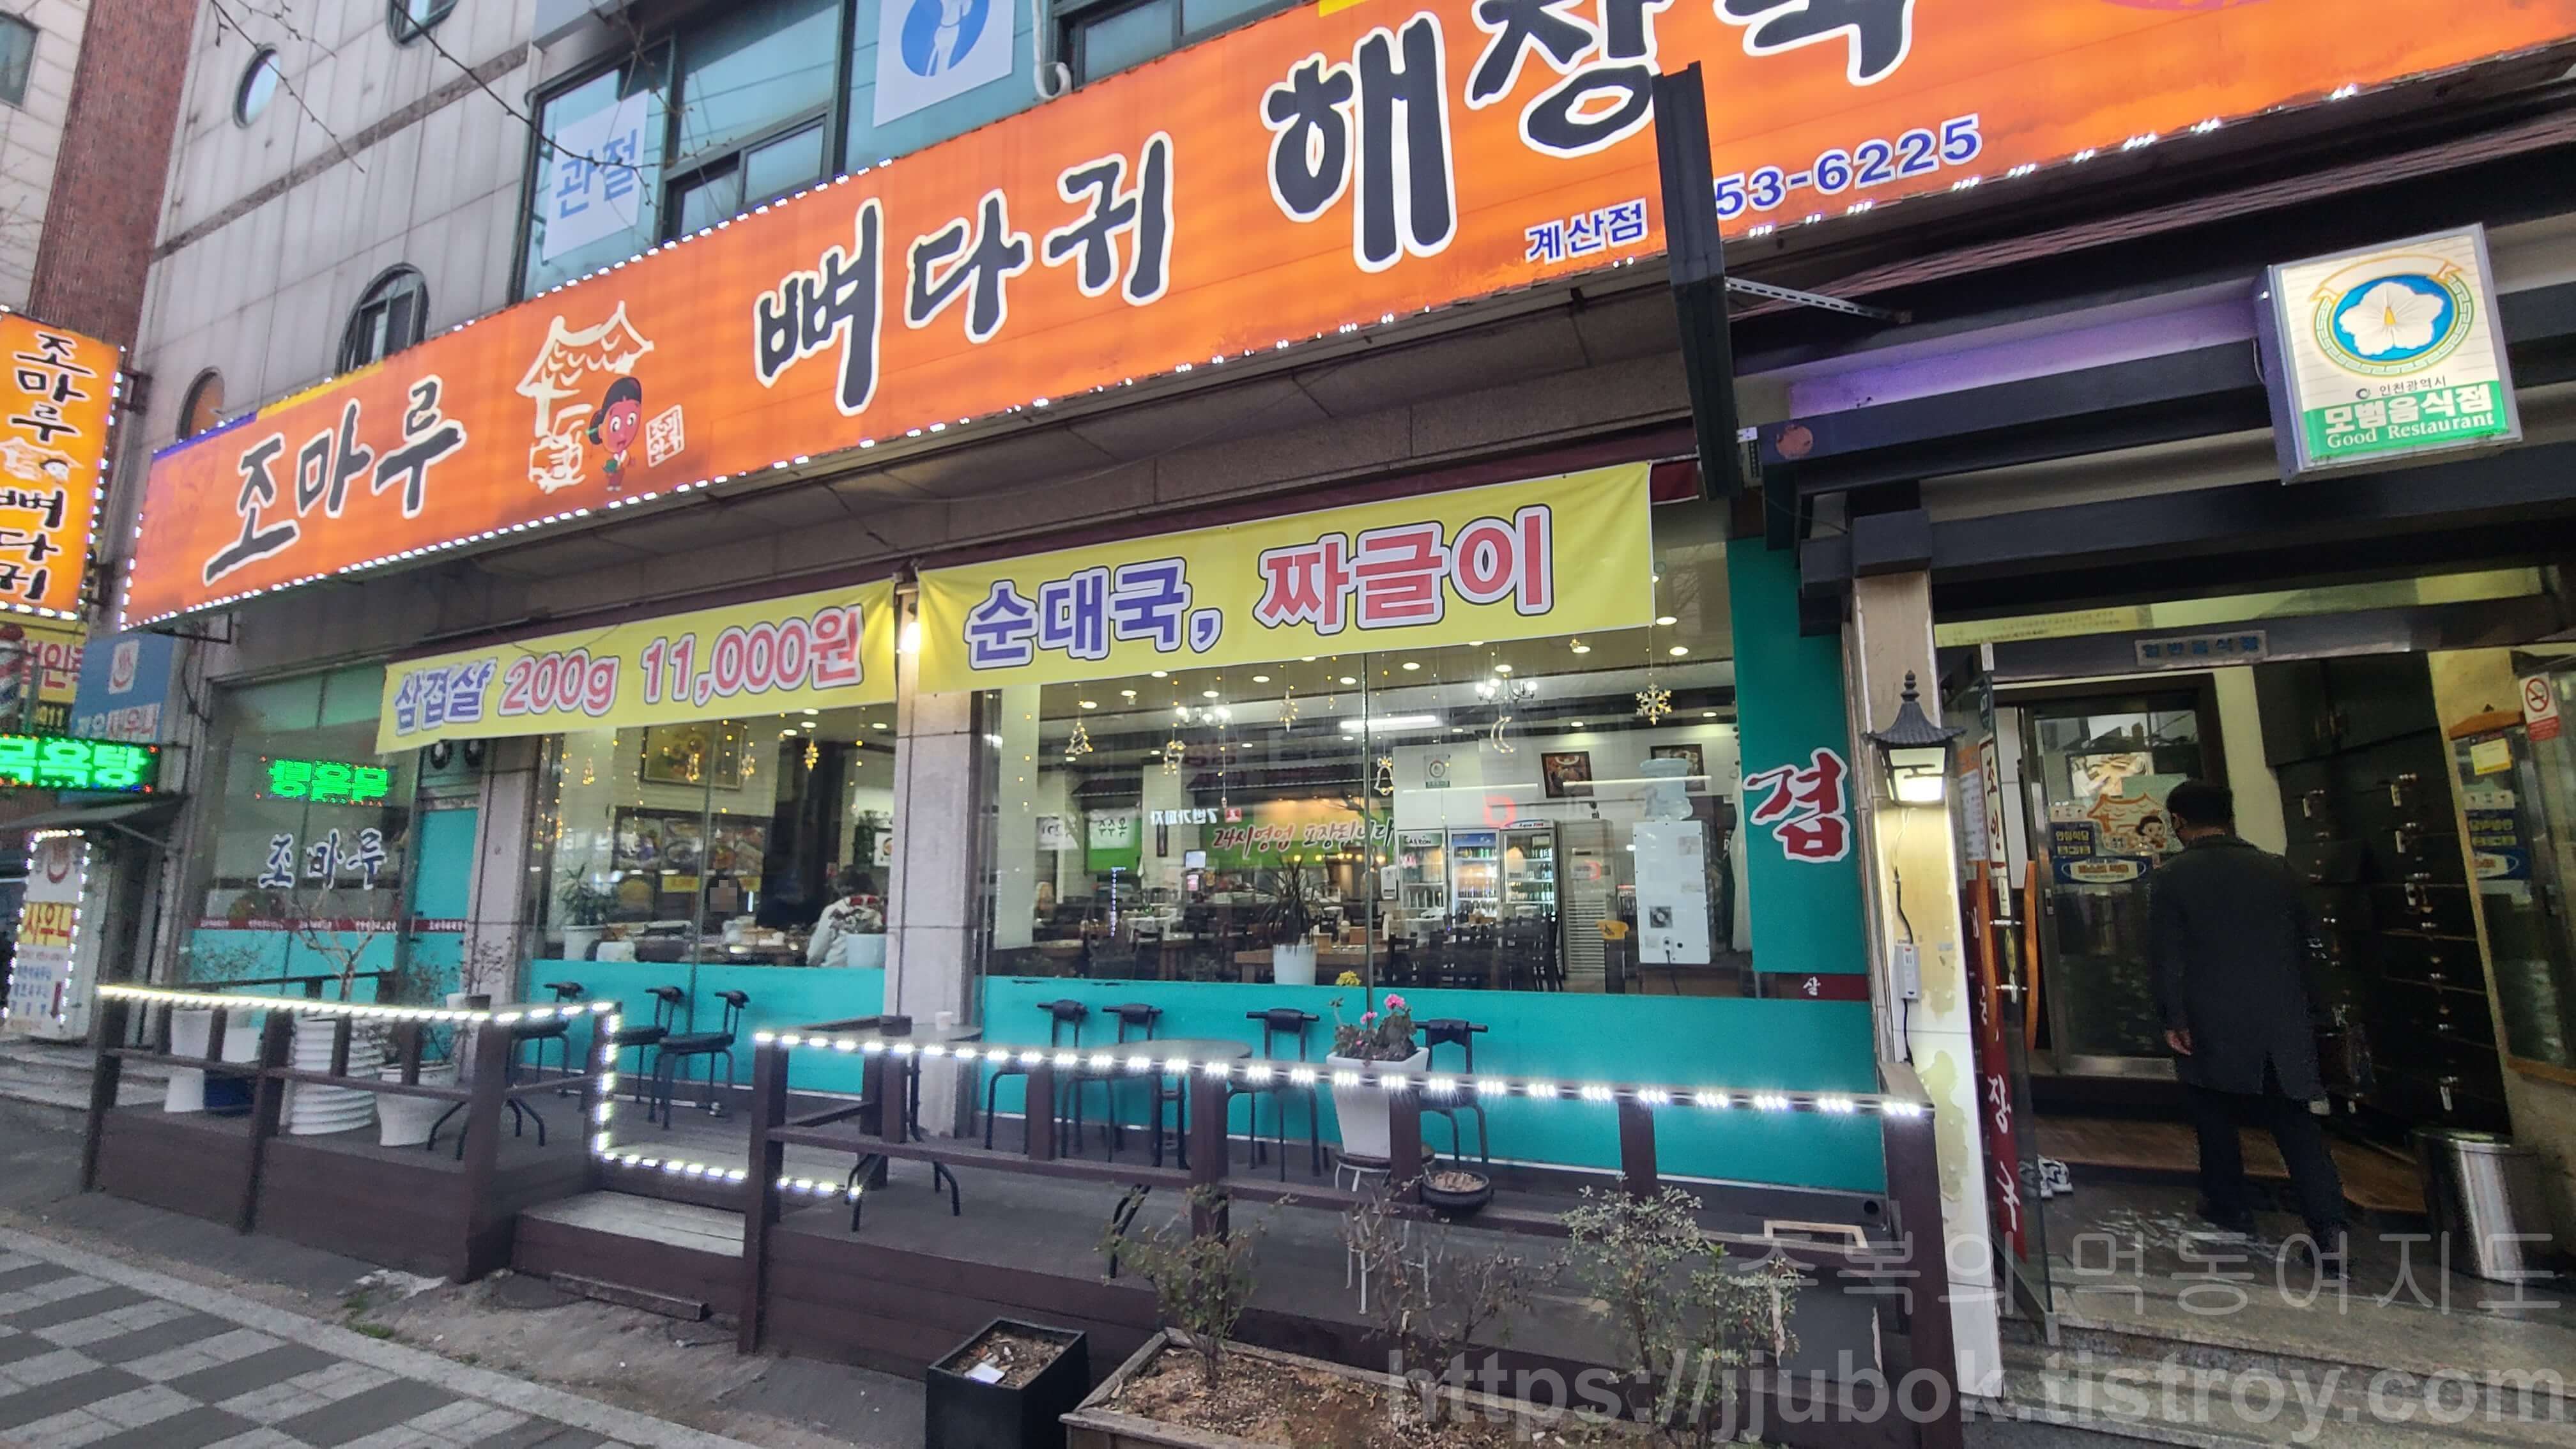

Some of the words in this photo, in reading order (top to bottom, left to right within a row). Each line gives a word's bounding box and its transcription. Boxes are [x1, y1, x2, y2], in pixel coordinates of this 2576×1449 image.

[556, 128, 638, 219] 관절
[1524, 197, 1648, 266] 계산점
[9, 331, 97, 443] 조마루
[203, 374, 467, 587] 조마루
[754, 131, 1174, 417] 뼈다귀
[2379, 376, 2447, 396] 인천광역시
[2324, 383, 2493, 436] 모범음식점
[2327, 427, 2377, 448] Good
[2387, 412, 2494, 440] Restaurant
[963, 555, 1223, 671] 순대국,
[1255, 503, 1555, 636] 짜글이
[394, 657, 498, 737] 삼겹살
[498, 647, 621, 717] 200g
[640, 603, 865, 708] 11,000원
[258, 829, 388, 890] 조마루
[1213, 823, 1296, 860] 24시영업
[23, 903, 72, 947] 사우나
